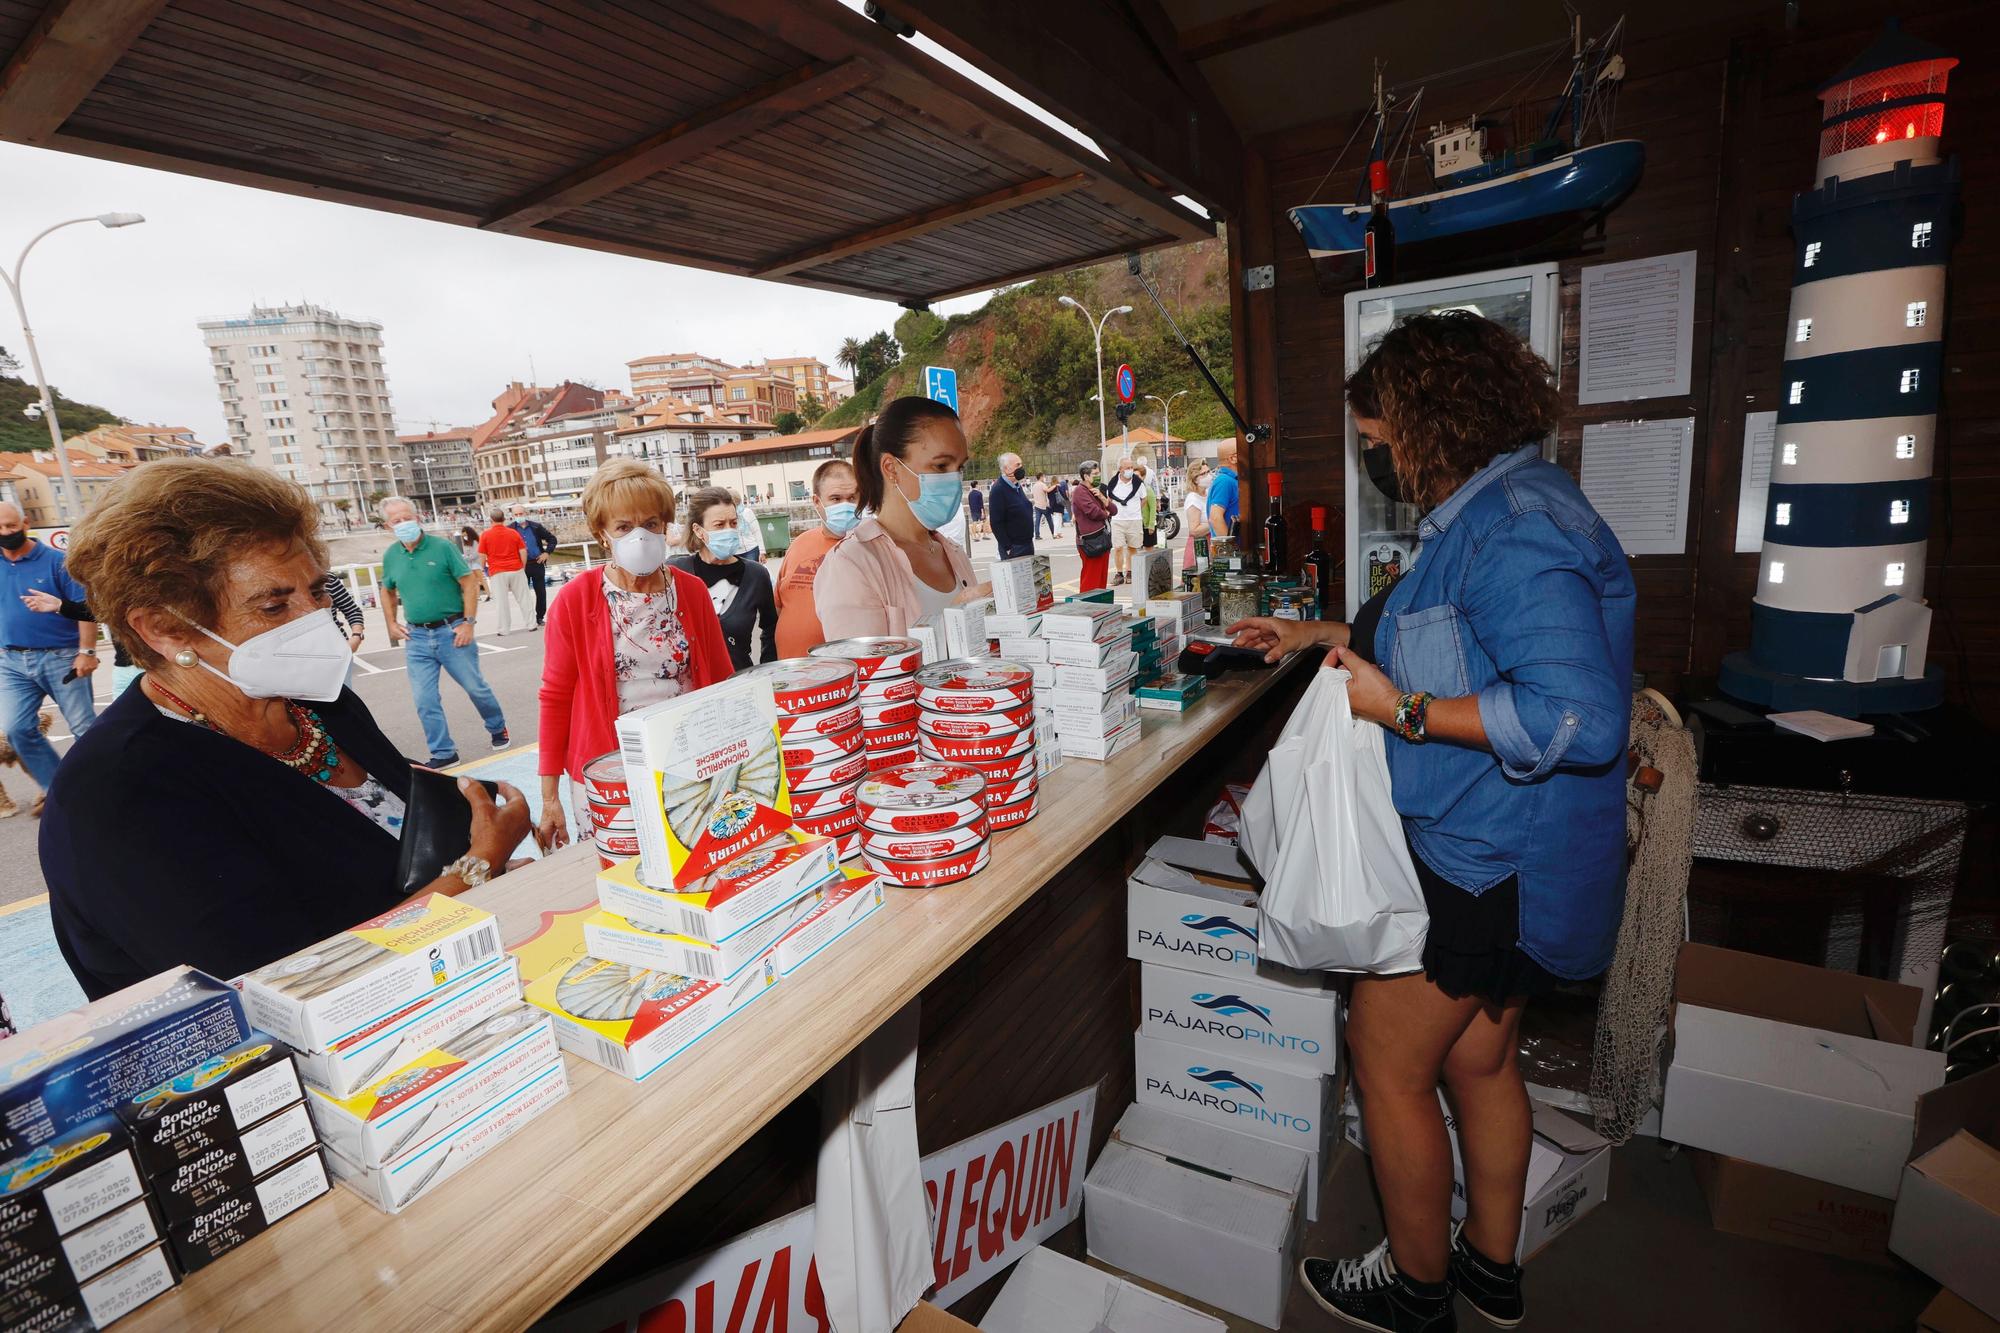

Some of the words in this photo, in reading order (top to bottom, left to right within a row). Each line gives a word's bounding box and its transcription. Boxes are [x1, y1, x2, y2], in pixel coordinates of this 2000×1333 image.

[1371, 576, 1392, 586] PUTA
[1372, 565, 1382, 576] DE
[808, 685, 850, 705] VIEIRA"
[695, 742, 733, 766] ESCABECHE
[733, 739, 748, 749] EN
[938, 747, 958, 757] "LA
[960, 744, 1008, 756] VIEIRA"
[696, 751, 751, 779] CHICHARRILLO
[904, 813, 945, 821] CALIDAD
[904, 818, 946, 826] SELECTA
[703, 837, 749, 869] VIEIRA"
[895, 871, 920, 882] "LA
[923, 861, 972, 879] VIEIRA"
[384, 907, 474, 947] CHICHARRILLOS
[444, 1004, 474, 1023] MOSQUERA
[1148, 1008, 1320, 1054] PÁJAROPINTO
[478, 1066, 508, 1086] MOSQUERA
[240, 1090, 291, 1119] 07/07/2026
[254, 1094, 266, 1104] SC
[1146, 1077, 1311, 1132] PÁJAROPINTO
[152, 1123, 178, 1141] del
[178, 1104, 221, 1129] Norte
[158, 1100, 208, 1126] Bonito
[492, 1107, 522, 1128] MOSQUERA
[176, 1150, 225, 1176] Bonito
[255, 1136, 305, 1165] 07/07/2026
[170, 1173, 195, 1190] del
[195, 1152, 238, 1177] Norte
[63, 1187, 129, 1223] 07/07/2026
[82, 1192, 98, 1204] SC
[268, 1184, 317, 1215] 07/07/2026
[0, 1208, 38, 1232] orte
[187, 1224, 212, 1240] del
[210, 1202, 254, 1228] Norte
[191, 1200, 241, 1227] Bonito
[80, 1234, 144, 1271] 07/07/2026
[0, 1254, 39, 1282] onito
